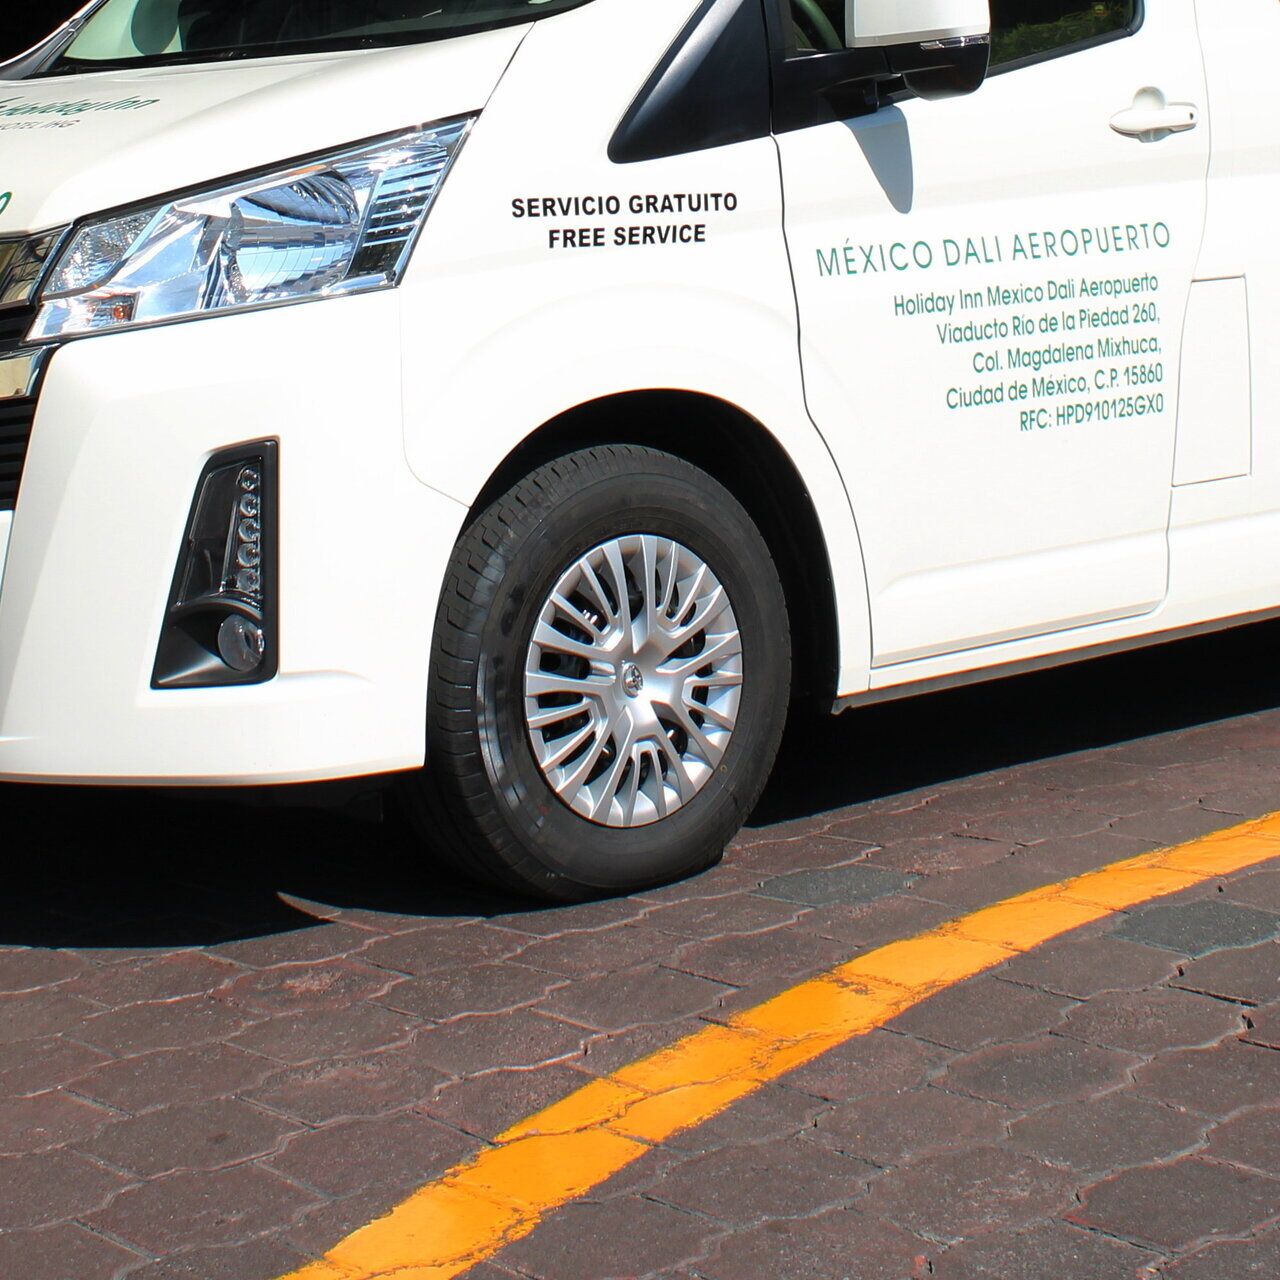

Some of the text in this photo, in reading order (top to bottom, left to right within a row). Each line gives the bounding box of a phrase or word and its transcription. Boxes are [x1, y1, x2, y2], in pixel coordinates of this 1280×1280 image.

[511, 192, 738, 218] SERVICIO GRATUITO
[548, 223, 706, 249] FREE SERVICE
[816, 221, 1171, 277] MÉXICO DALI AEROPUERTO
[893, 271, 1160, 317] Holiday Inn Mexico Dali Aeropuerto
[936, 317, 1009, 345] Viaducto
[1012, 313, 1036, 337] Río
[1038, 312, 1059, 333] de
[1062, 309, 1077, 331] la
[1078, 304, 1130, 329] Piedad
[972, 334, 1163, 374] Col. Magdalena Mixhuca,
[945, 361, 1164, 410] Ciudad de México, C.P. 15860
[1019, 391, 1165, 432] RFC: HPD910125GX0
